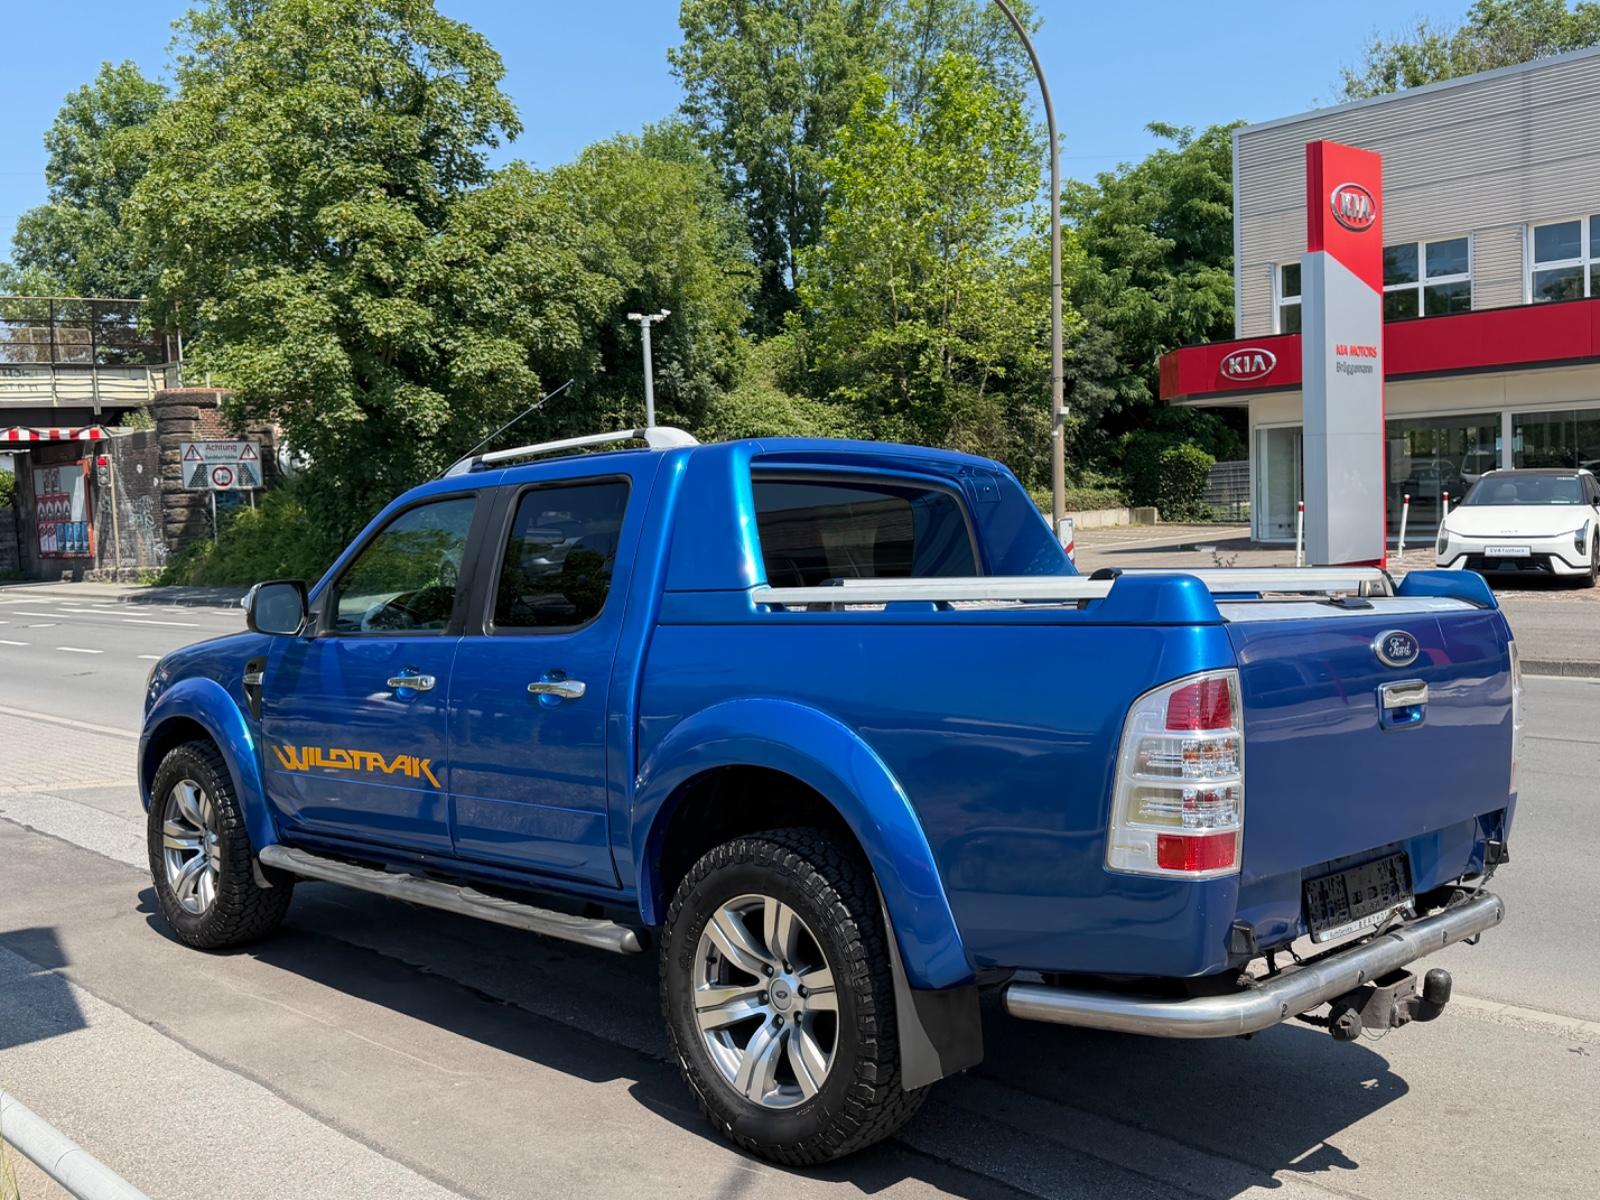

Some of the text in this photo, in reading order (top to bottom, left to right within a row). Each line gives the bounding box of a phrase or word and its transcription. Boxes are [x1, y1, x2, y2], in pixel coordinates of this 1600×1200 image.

[1340, 191, 1371, 220] KIA
[1335, 343, 1377, 358] KIA MOTORS
[1228, 354, 1266, 374] KIA
[205, 444, 238, 453] Achtung
[272, 744, 442, 788] WILDTRAK
